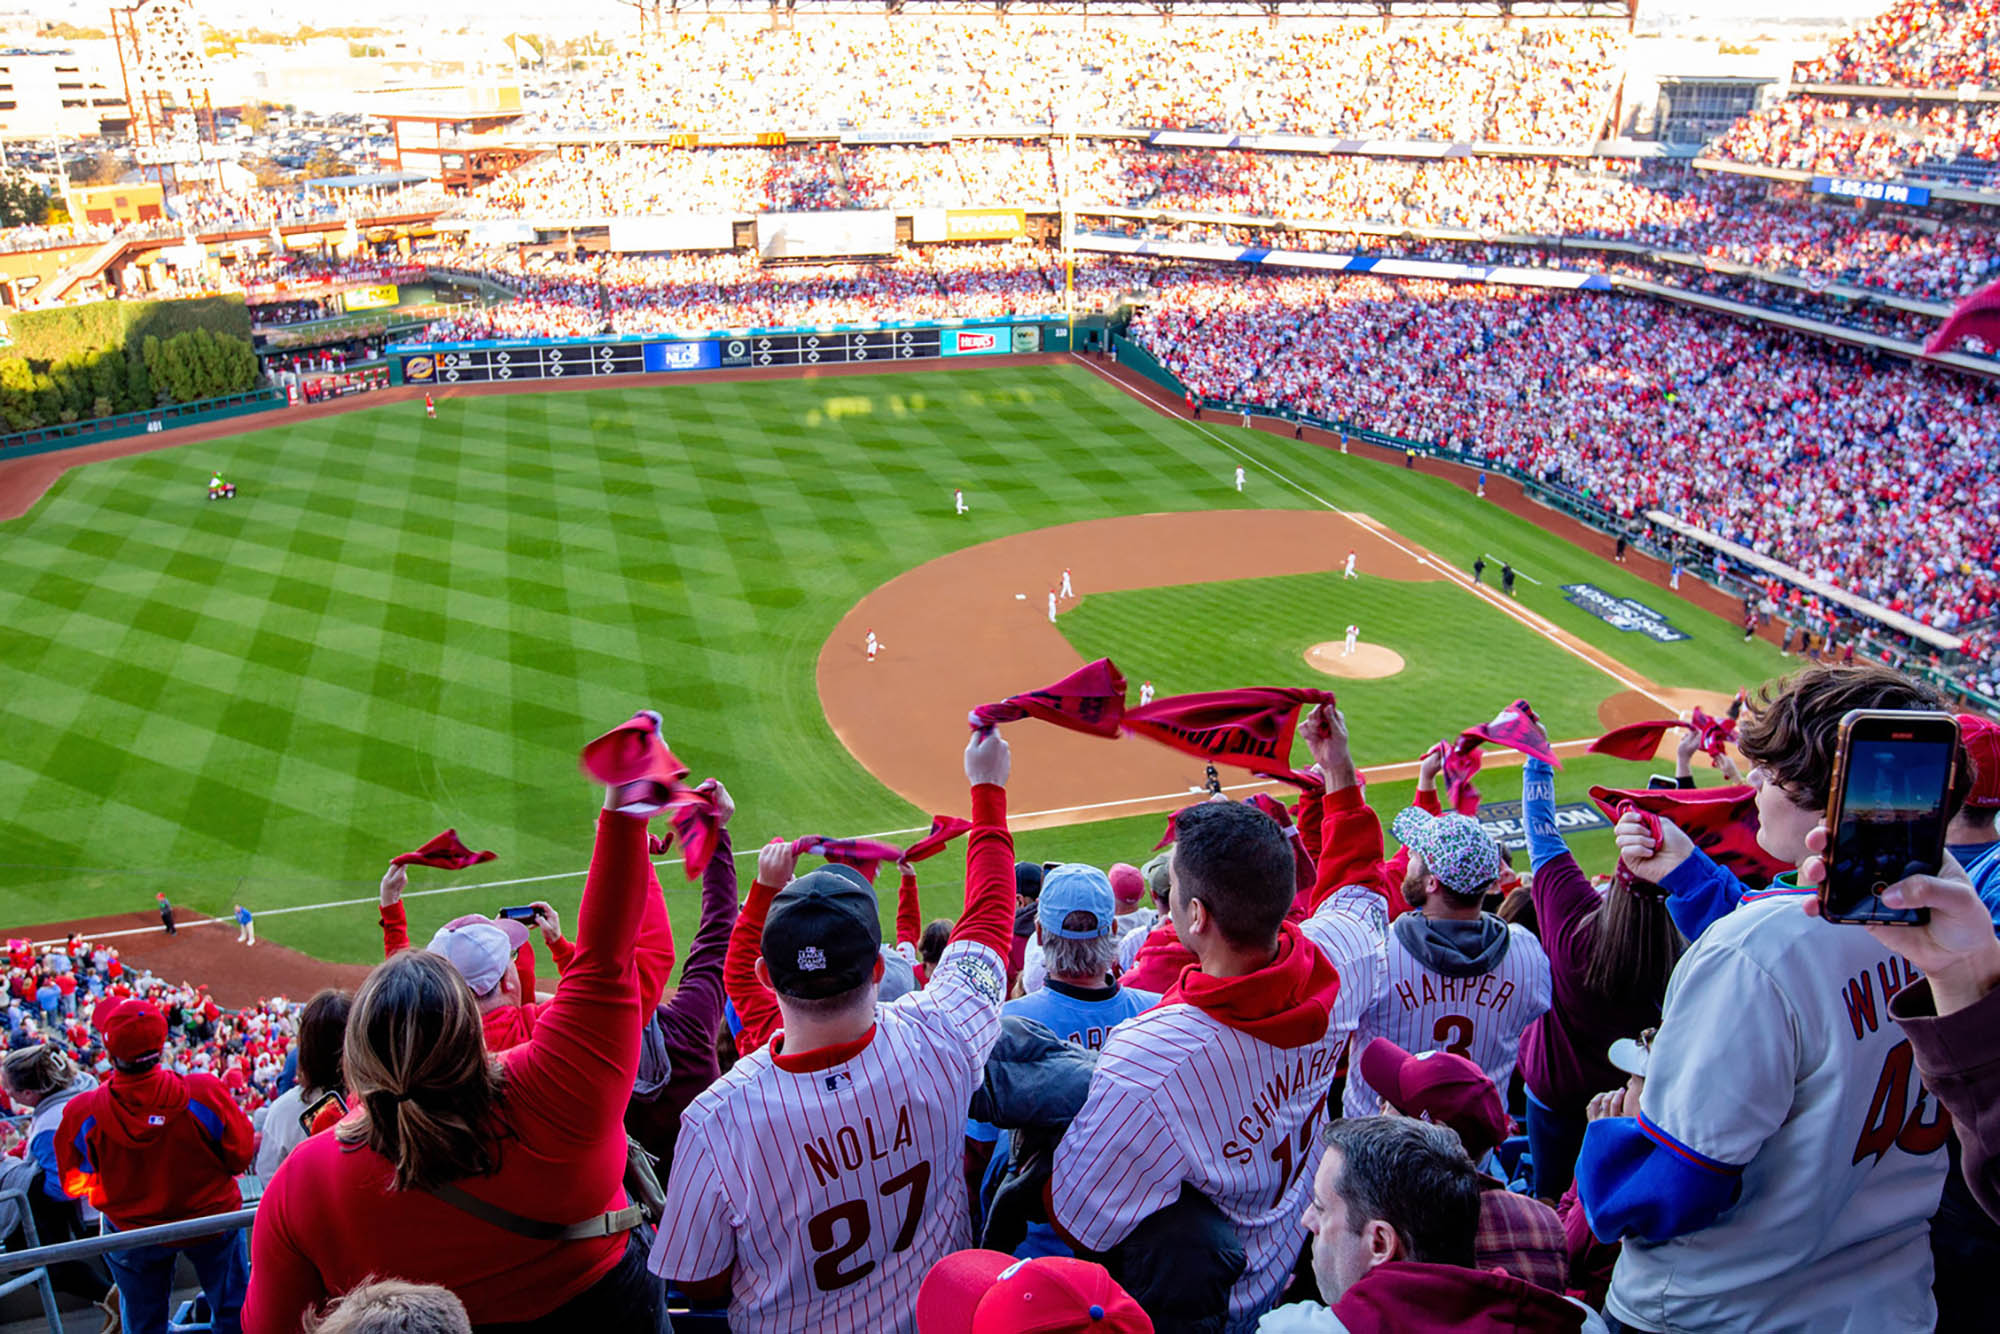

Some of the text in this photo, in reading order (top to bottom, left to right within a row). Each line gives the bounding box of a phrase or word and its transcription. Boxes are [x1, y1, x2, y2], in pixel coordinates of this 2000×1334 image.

[949, 215, 1021, 233] TOYOTA
[665, 351, 700, 364] NLCS
[1395, 973, 1515, 1013] HARPER
[803, 1104, 912, 1187] NOLA
[808, 1160, 931, 1291] 27
